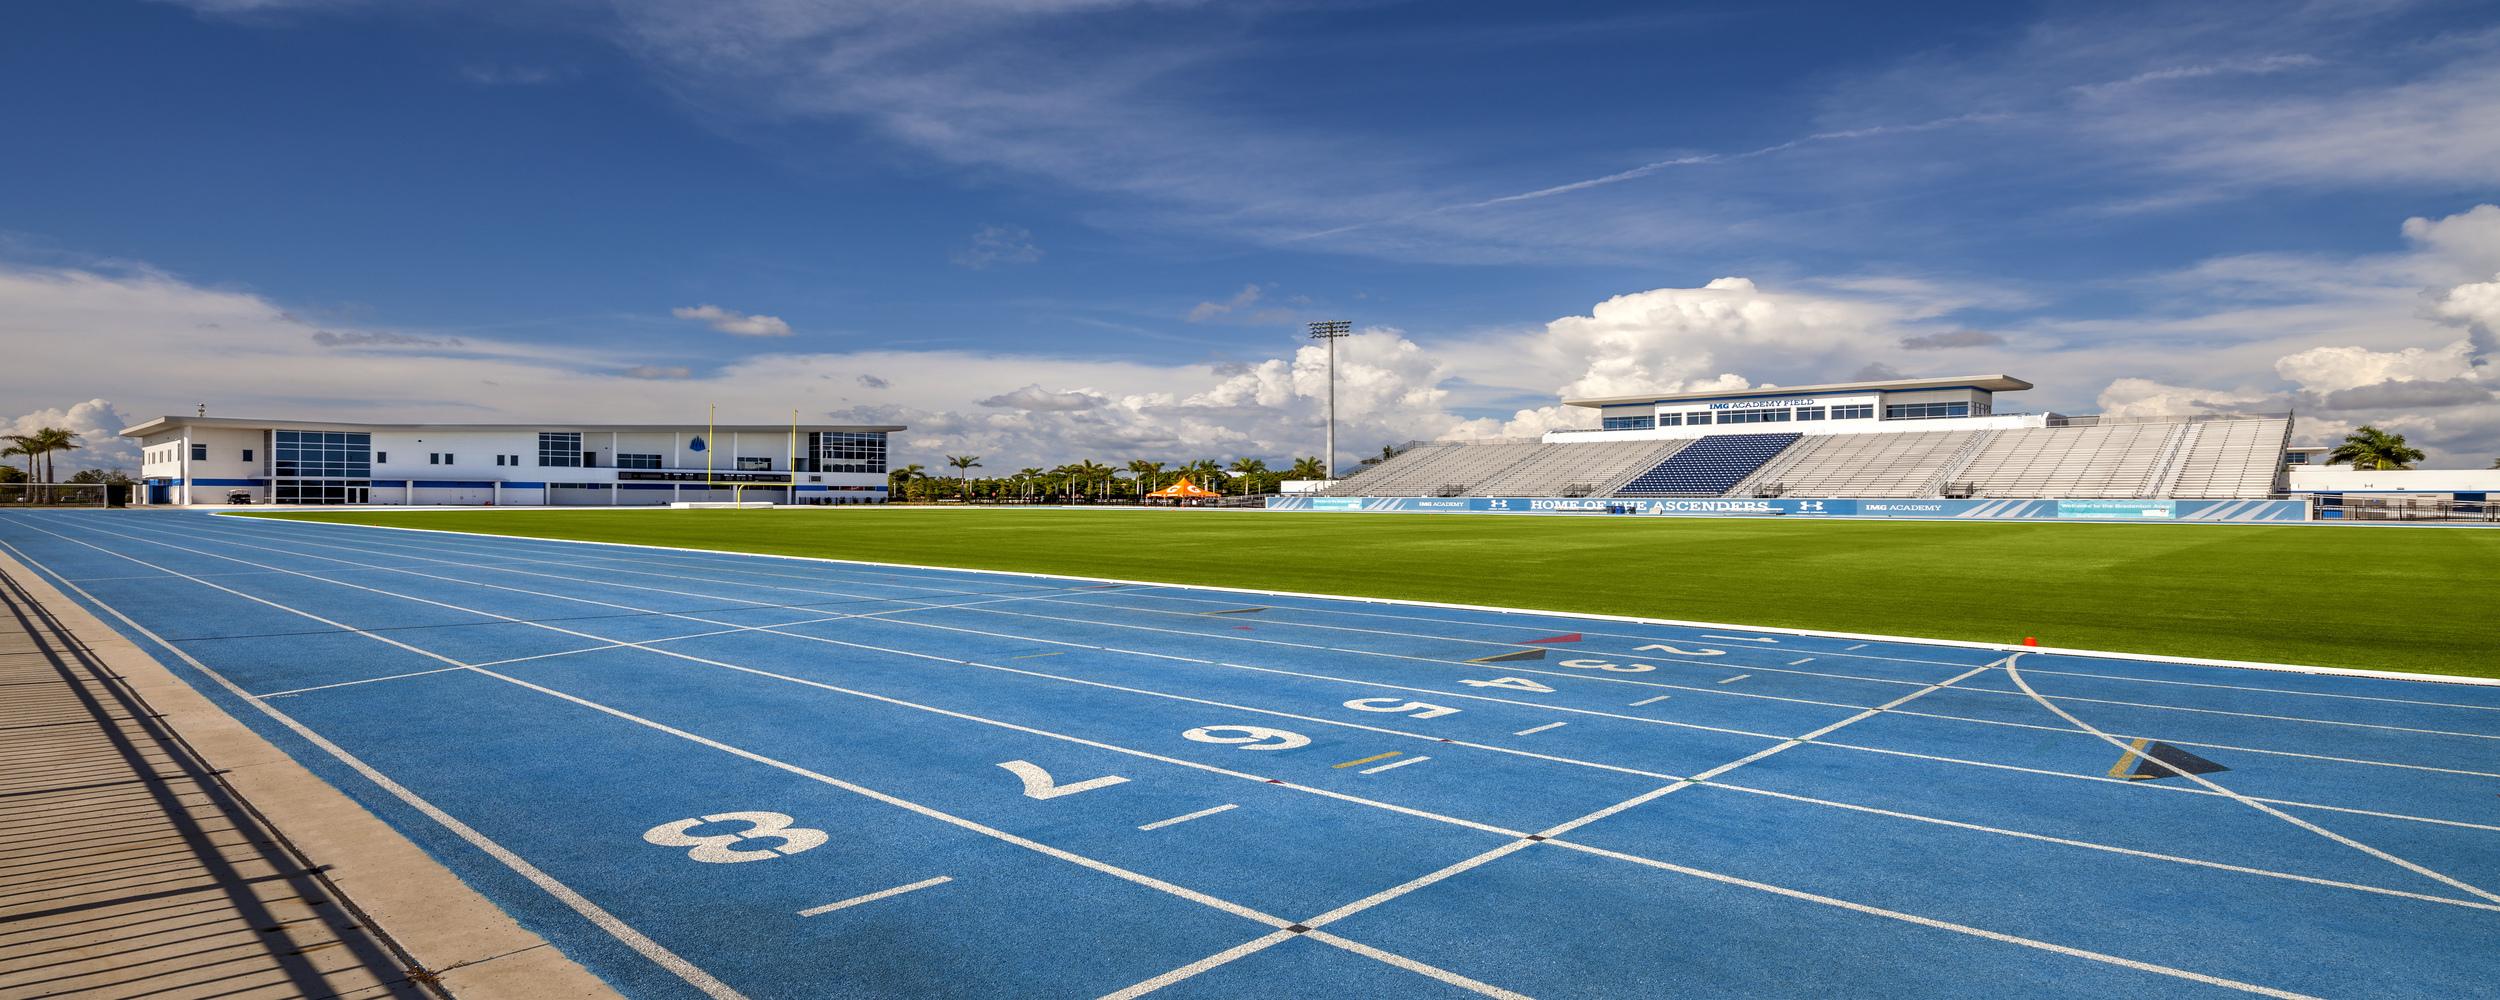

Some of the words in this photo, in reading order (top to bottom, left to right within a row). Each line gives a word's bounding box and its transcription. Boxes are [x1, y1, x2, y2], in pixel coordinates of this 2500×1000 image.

[1732, 400, 1782, 409] ACADEMY
[1784, 399, 1815, 407] FIELD
[1530, 500, 1580, 510] HOME
[1584, 500, 1607, 509] OF
[1652, 501, 1769, 511] ASCENDERS
[1632, 644, 1727, 656] 2
[1559, 660, 1657, 673] 3
[1458, 676, 1557, 693] 4
[1343, 697, 1462, 720] 5
[1181, 724, 1312, 751] 6
[995, 759, 1132, 801] 7
[642, 810, 829, 864] 8
